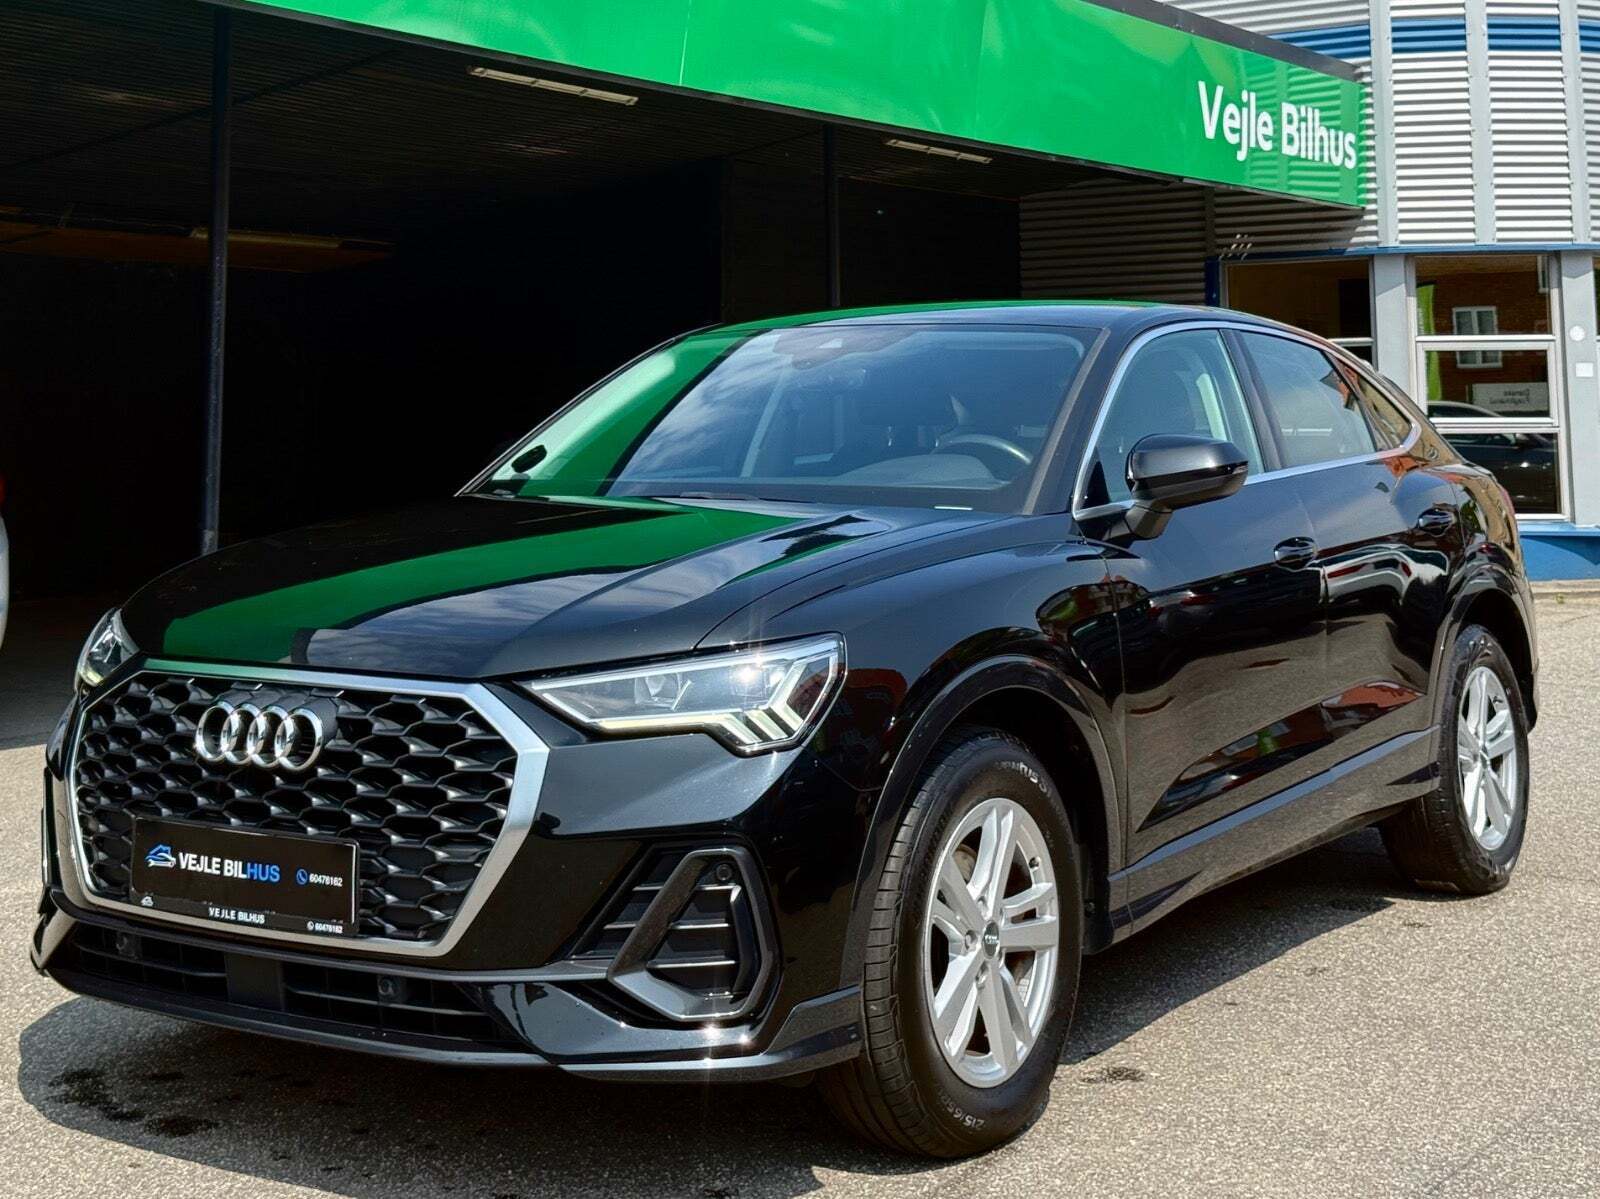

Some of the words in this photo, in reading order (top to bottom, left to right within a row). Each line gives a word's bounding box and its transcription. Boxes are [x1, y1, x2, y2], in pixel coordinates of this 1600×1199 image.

[1198, 80, 1274, 161] Vejle
[1281, 102, 1357, 169] Bilhus
[179, 852, 221, 875] VEJLE
[223, 859, 280, 883] BILHUS
[209, 907, 236, 920] VEJLE
[238, 911, 265, 924] BILHUS
